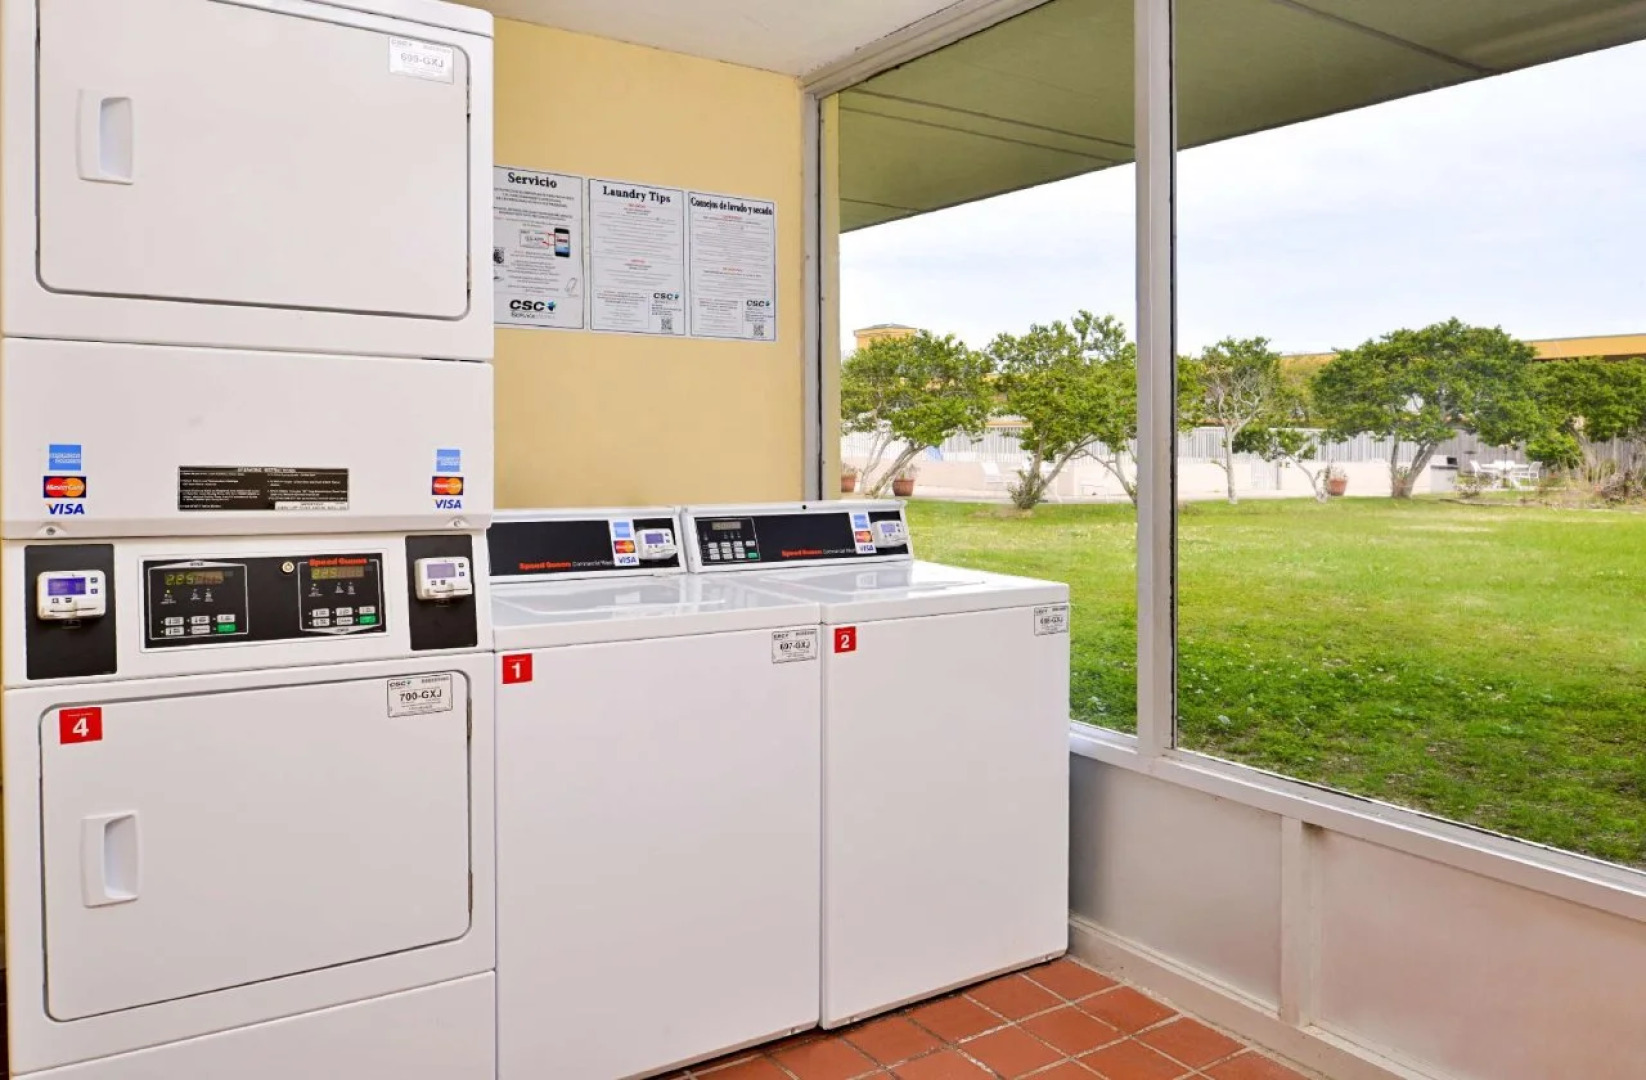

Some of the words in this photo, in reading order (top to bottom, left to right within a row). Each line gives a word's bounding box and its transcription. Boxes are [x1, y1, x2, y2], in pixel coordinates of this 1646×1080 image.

[507, 171, 557, 189] Servicio
[602, 185, 647, 203] Laundry
[648, 190, 671, 205] Tips
[690, 196, 718, 210] Consejos
[719, 200, 727, 210] de
[727, 201, 748, 213] lavado
[748, 206, 753, 216] y
[753, 206, 773, 216] secado
[652, 292, 673, 300] CSC
[509, 299, 546, 312] CSC
[746, 299, 765, 308] CSC
[47, 503, 85, 515] VISA
[434, 499, 462, 509] VISA
[618, 556, 637, 564] VISA
[841, 634, 851, 649] 2
[511, 662, 521, 679] 1
[399, 688, 442, 702] 700-GXJ
[72, 716, 90, 738] 4
